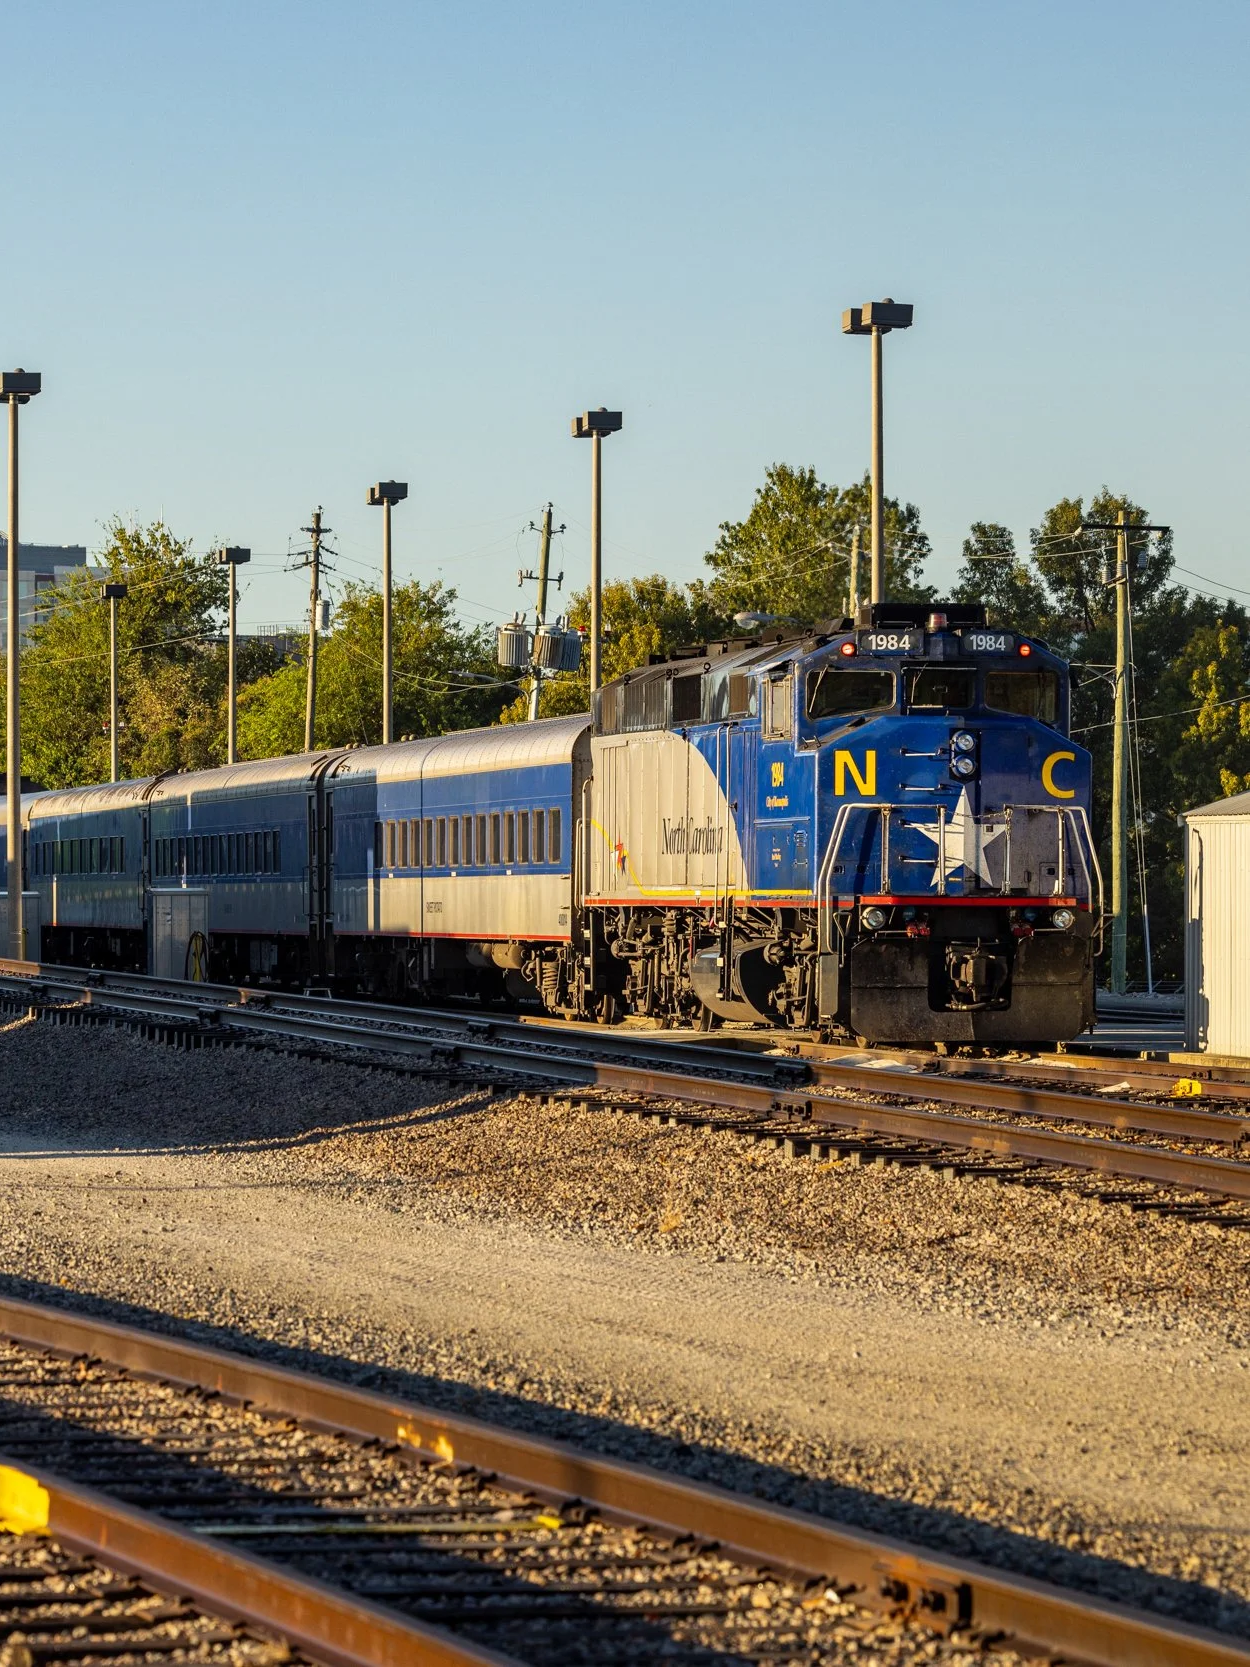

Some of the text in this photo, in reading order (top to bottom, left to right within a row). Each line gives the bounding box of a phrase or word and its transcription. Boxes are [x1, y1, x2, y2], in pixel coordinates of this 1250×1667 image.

[868, 634, 911, 650] 1984
[969, 634, 1006, 651] 1984
[834, 749, 1076, 799] N C
[661, 816, 686, 855] North
